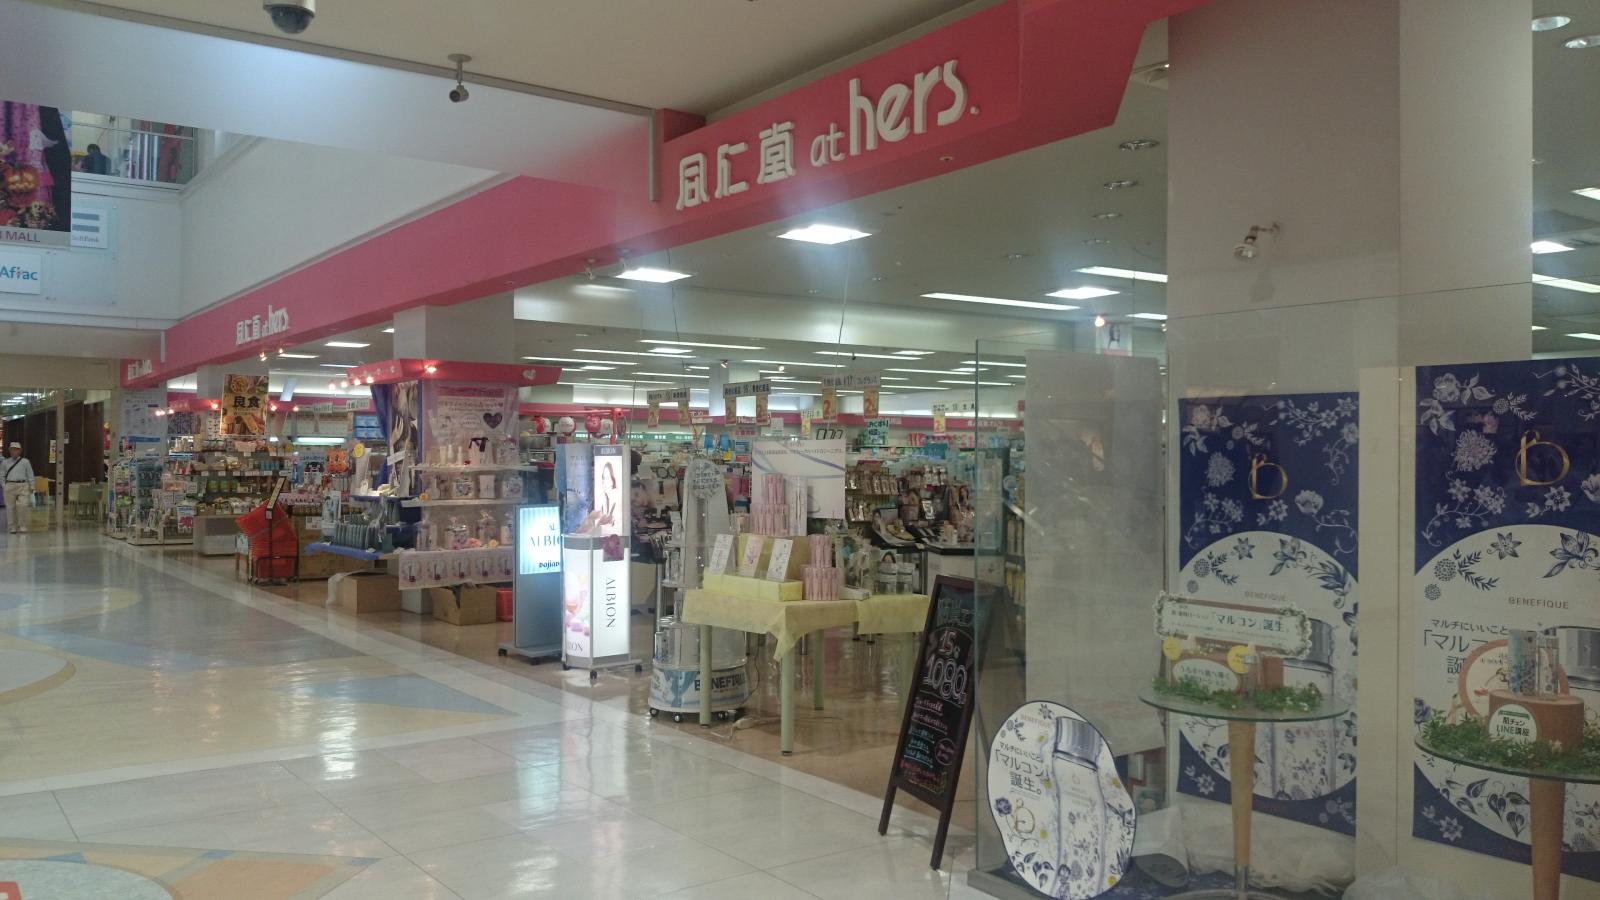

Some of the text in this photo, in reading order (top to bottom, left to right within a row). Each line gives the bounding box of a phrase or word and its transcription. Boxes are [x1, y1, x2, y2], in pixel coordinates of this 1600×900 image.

[810, 123, 845, 167] at
[5, 230, 41, 243] MALL
[232, 395, 261, 408] 良食
[605, 576, 617, 628] ALBION
[1508, 596, 1569, 610] BENEFIQUE
[1432, 618, 1510, 636] マルチにいいこと
